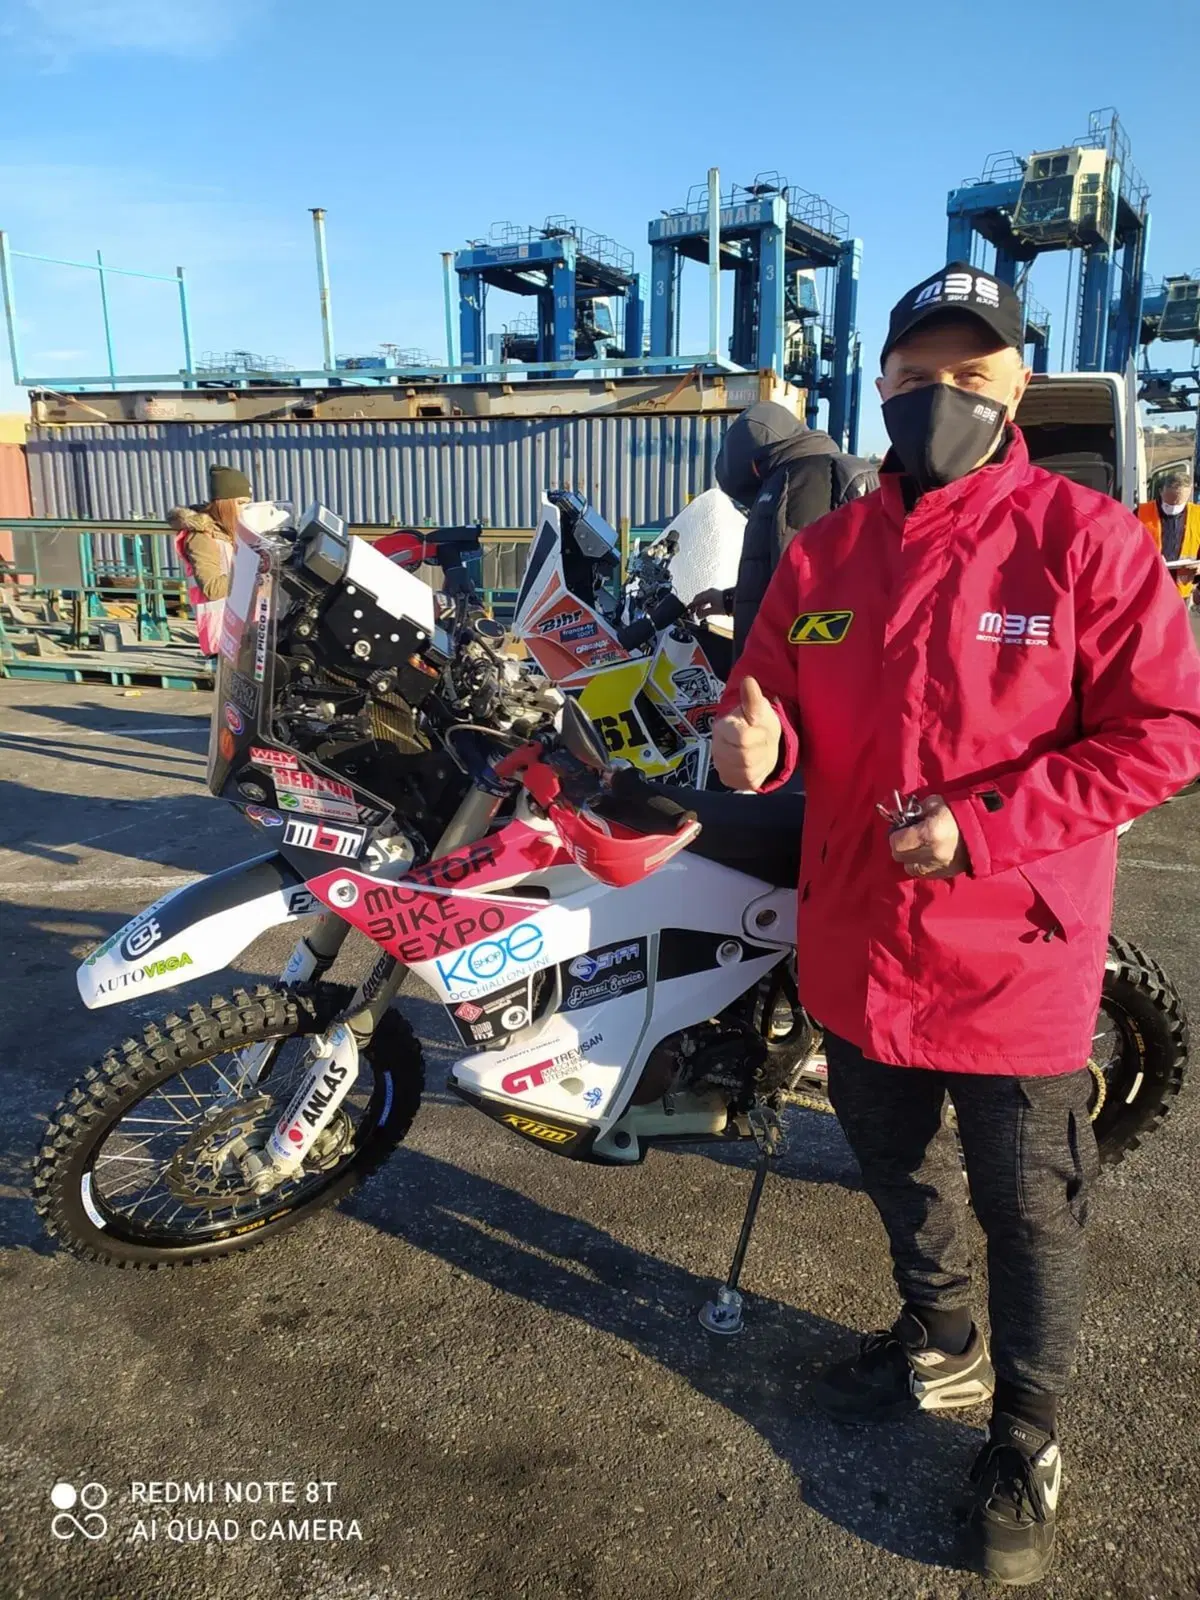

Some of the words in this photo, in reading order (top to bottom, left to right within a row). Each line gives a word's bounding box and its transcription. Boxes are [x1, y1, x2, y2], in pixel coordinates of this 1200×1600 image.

[766, 264, 775, 281] 3
[656, 280, 664, 296] 3
[258, 614, 270, 653] PICCO
[537, 609, 584, 635] Bihr
[252, 748, 297, 764] WHY
[363, 845, 497, 915] MOTOR
[398, 907, 505, 962] EXPO
[473, 951, 501, 969] SHOP
[501, 1058, 554, 1094] GT
[553, 1033, 604, 1065] TREVISAN
[302, 1060, 348, 1127] ANLAS
[1013, 1429, 1026, 1441] AIR
